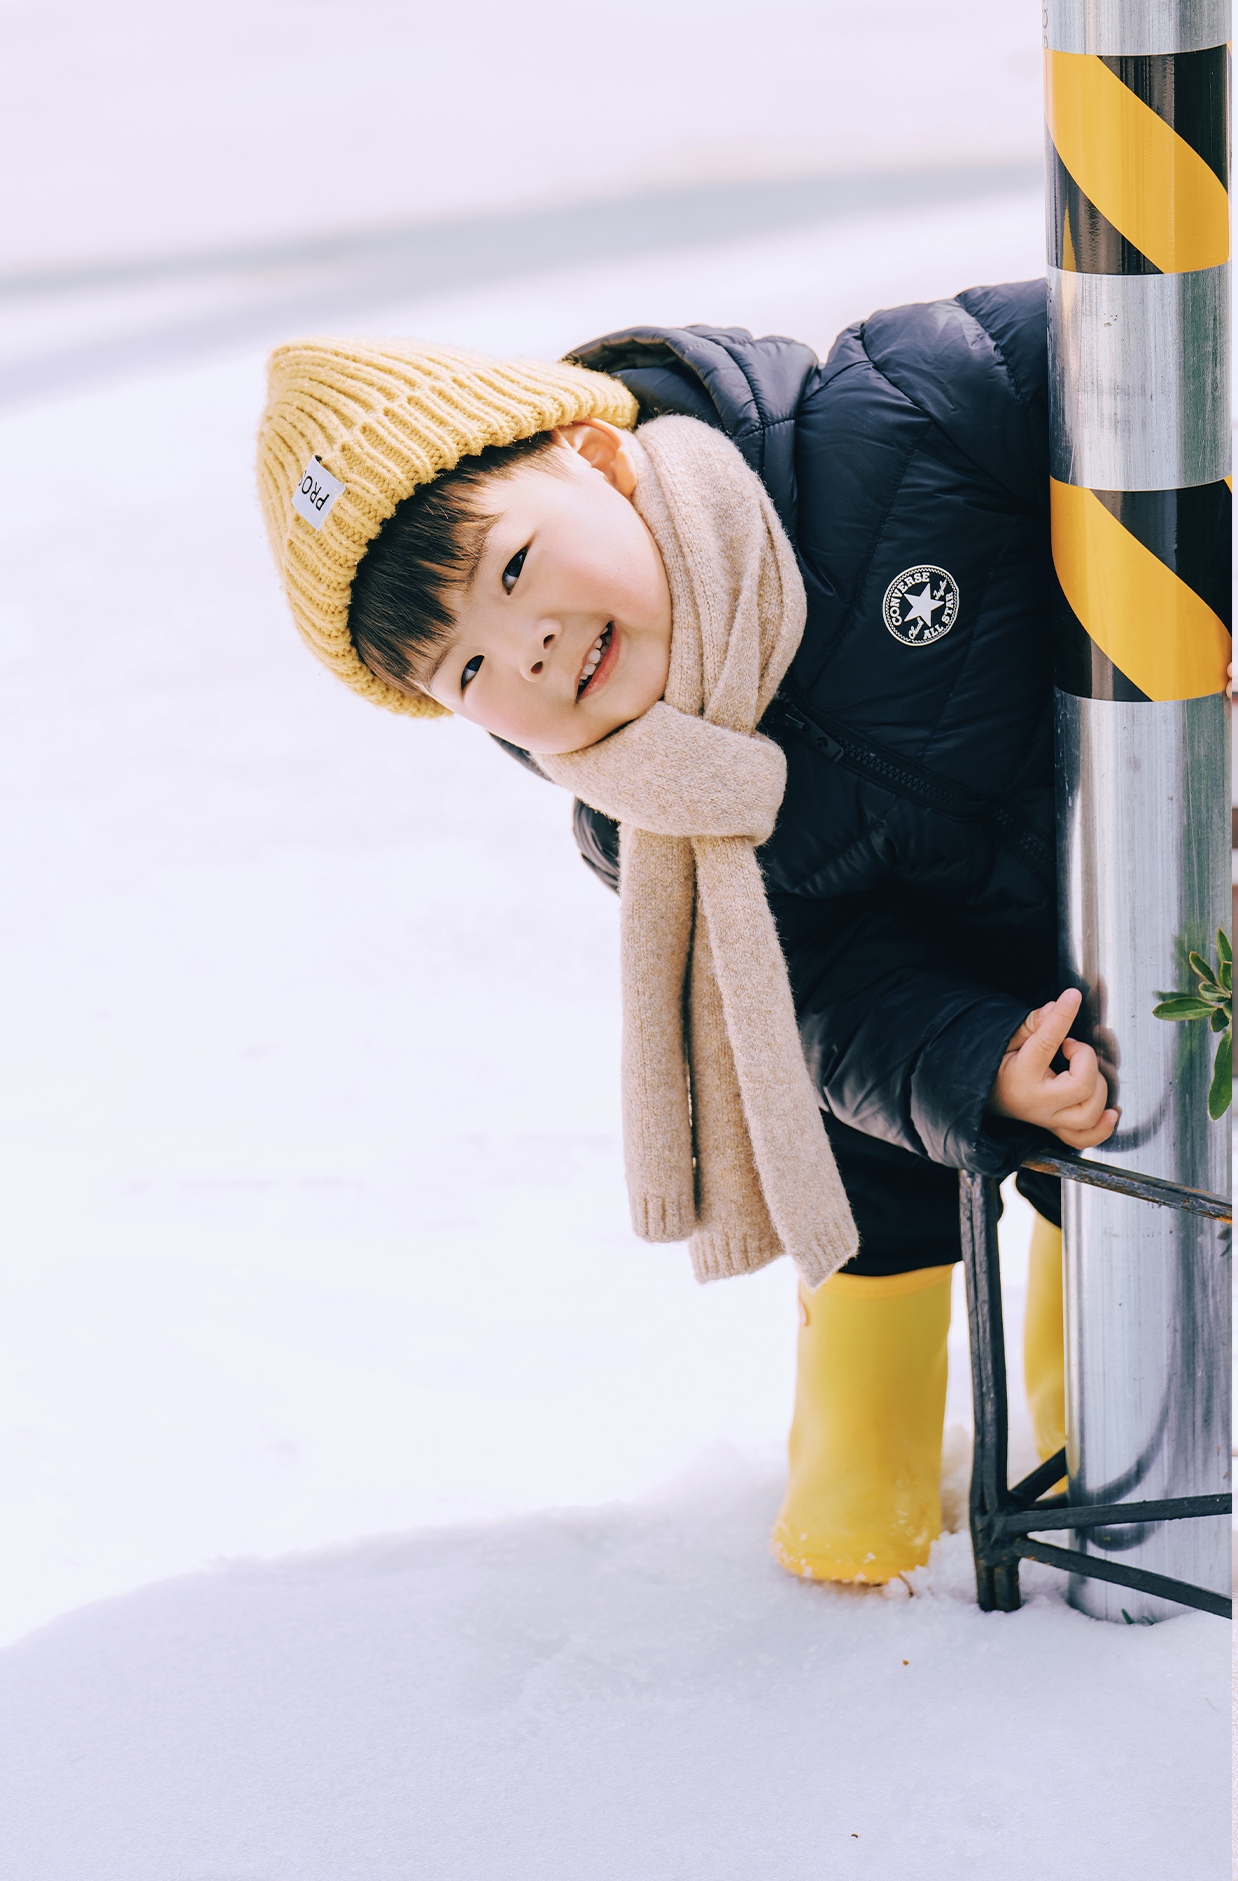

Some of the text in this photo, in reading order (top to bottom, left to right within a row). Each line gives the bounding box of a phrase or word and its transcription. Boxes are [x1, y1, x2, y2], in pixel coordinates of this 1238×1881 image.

[299, 470, 330, 511] PRO
[890, 572, 930, 626] CONVERSE
[923, 592, 954, 640] ALL STAR
